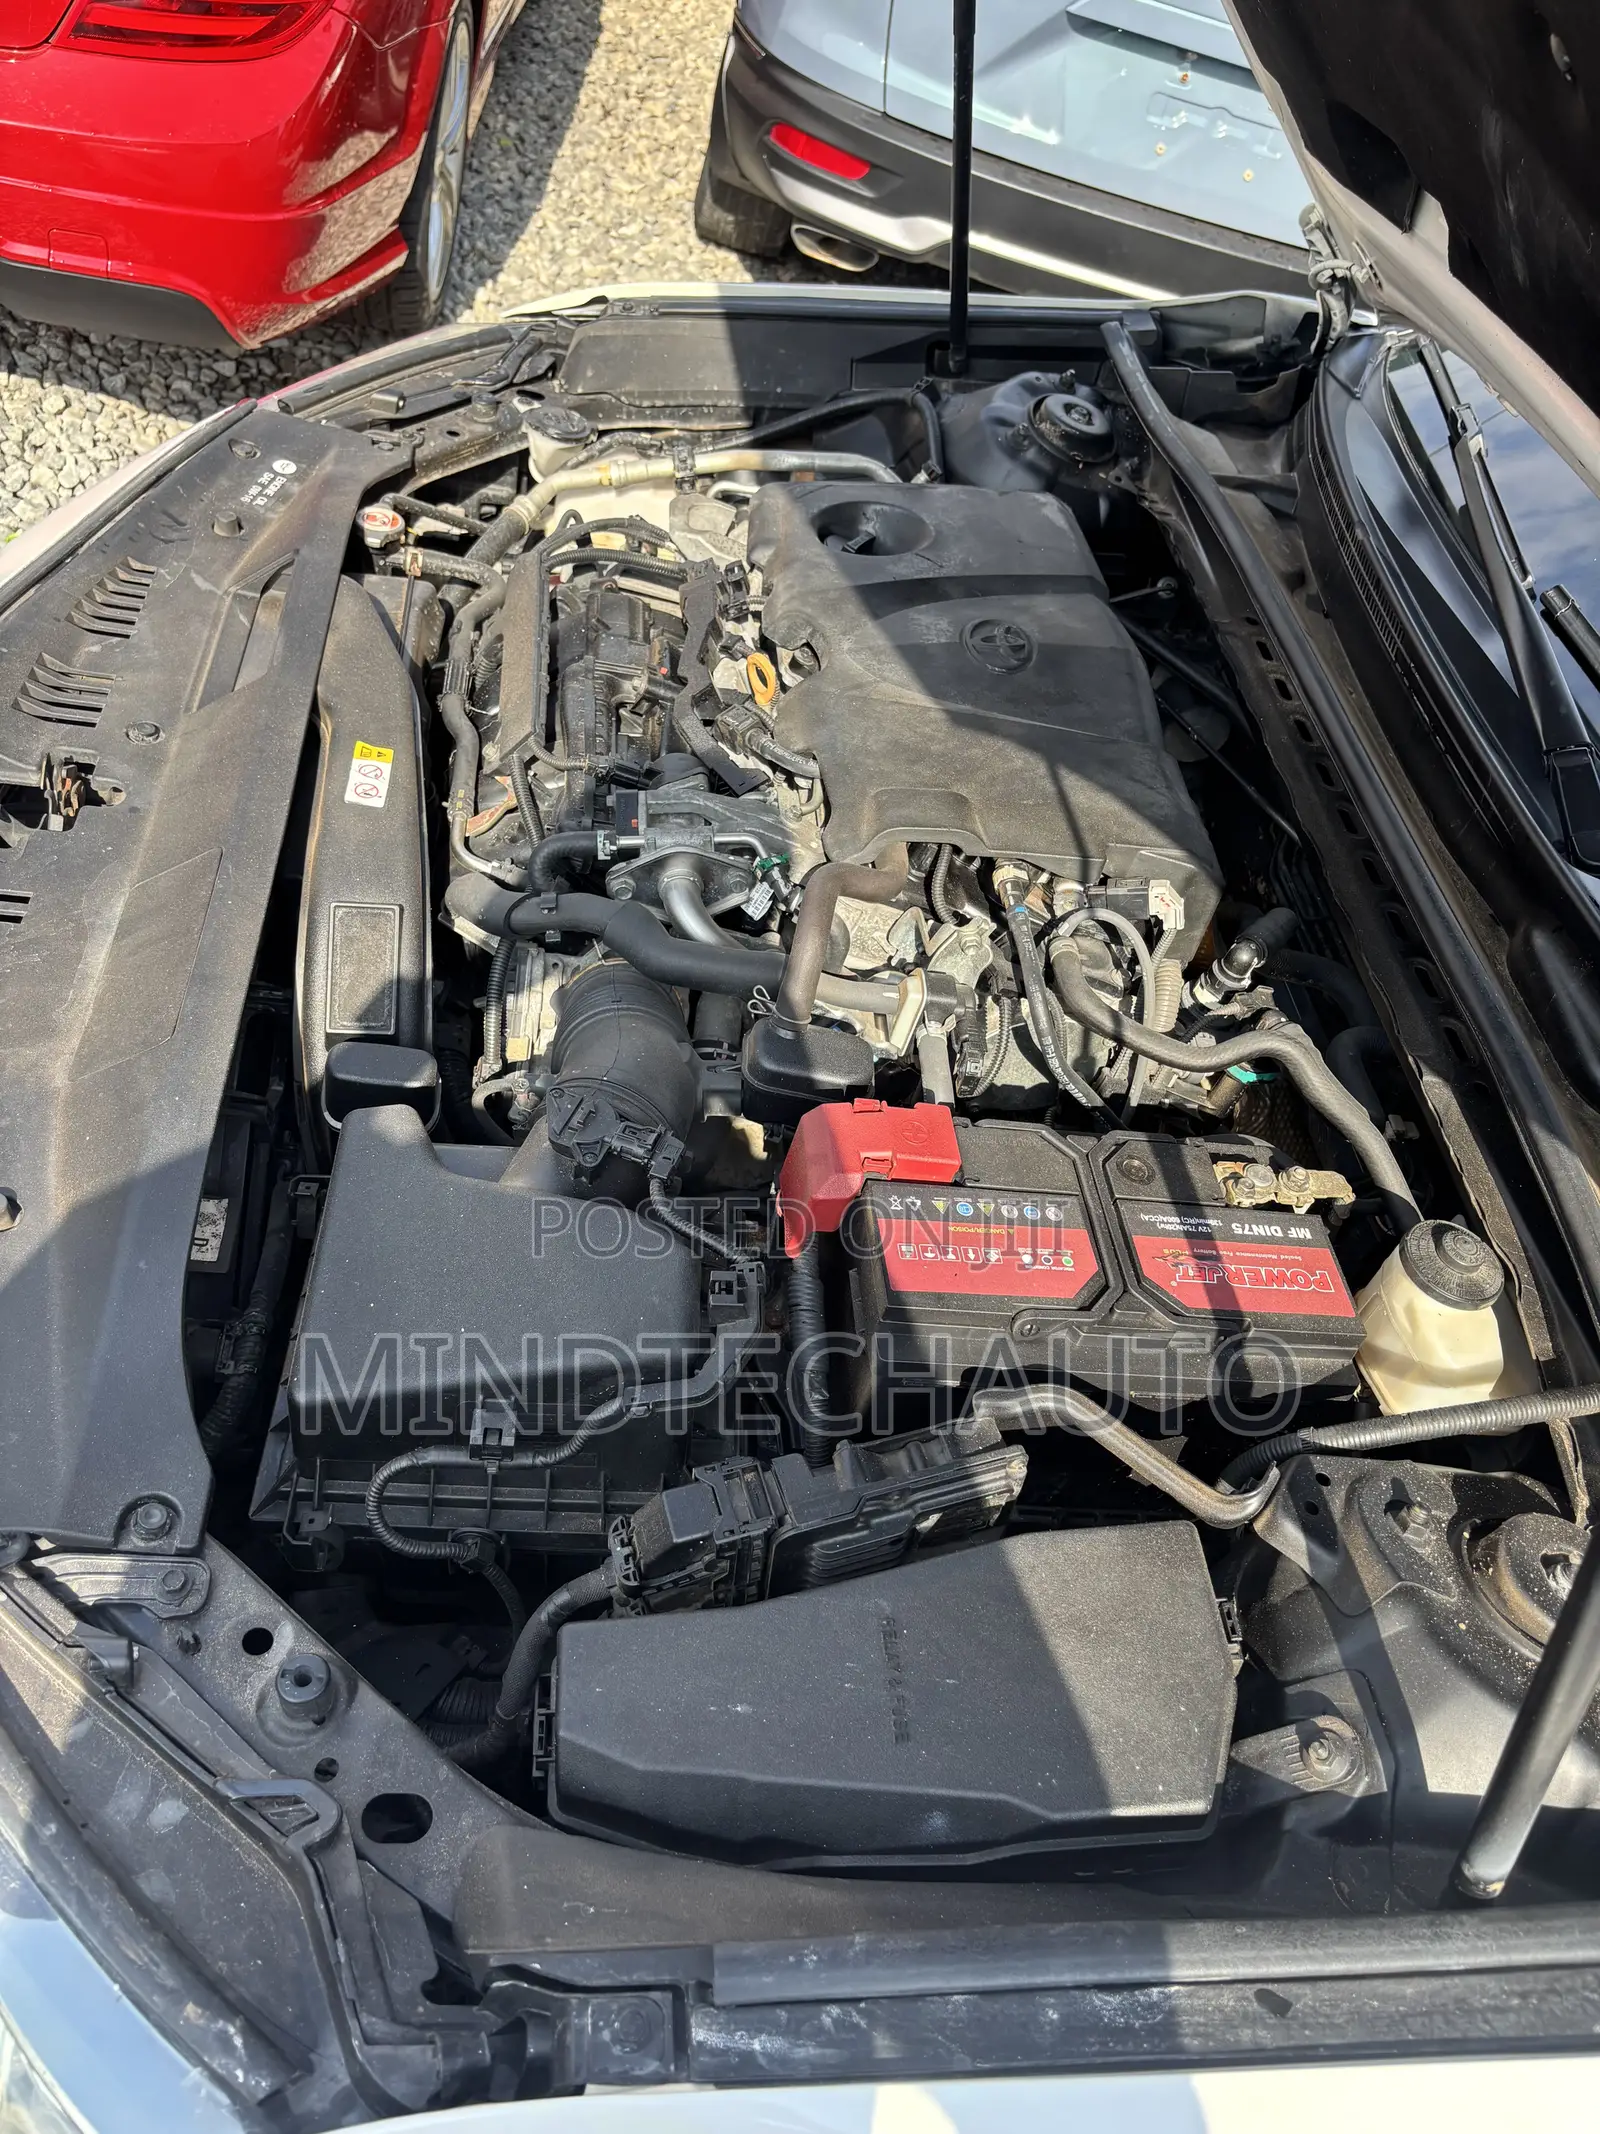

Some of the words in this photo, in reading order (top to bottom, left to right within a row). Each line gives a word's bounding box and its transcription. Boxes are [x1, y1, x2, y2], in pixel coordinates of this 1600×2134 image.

[1231, 1222, 1284, 1238] DIN75
[1287, 1226, 1313, 1240] MF
[1176, 1264, 1223, 1284] JET
[1222, 1264, 1335, 1293] POWER
